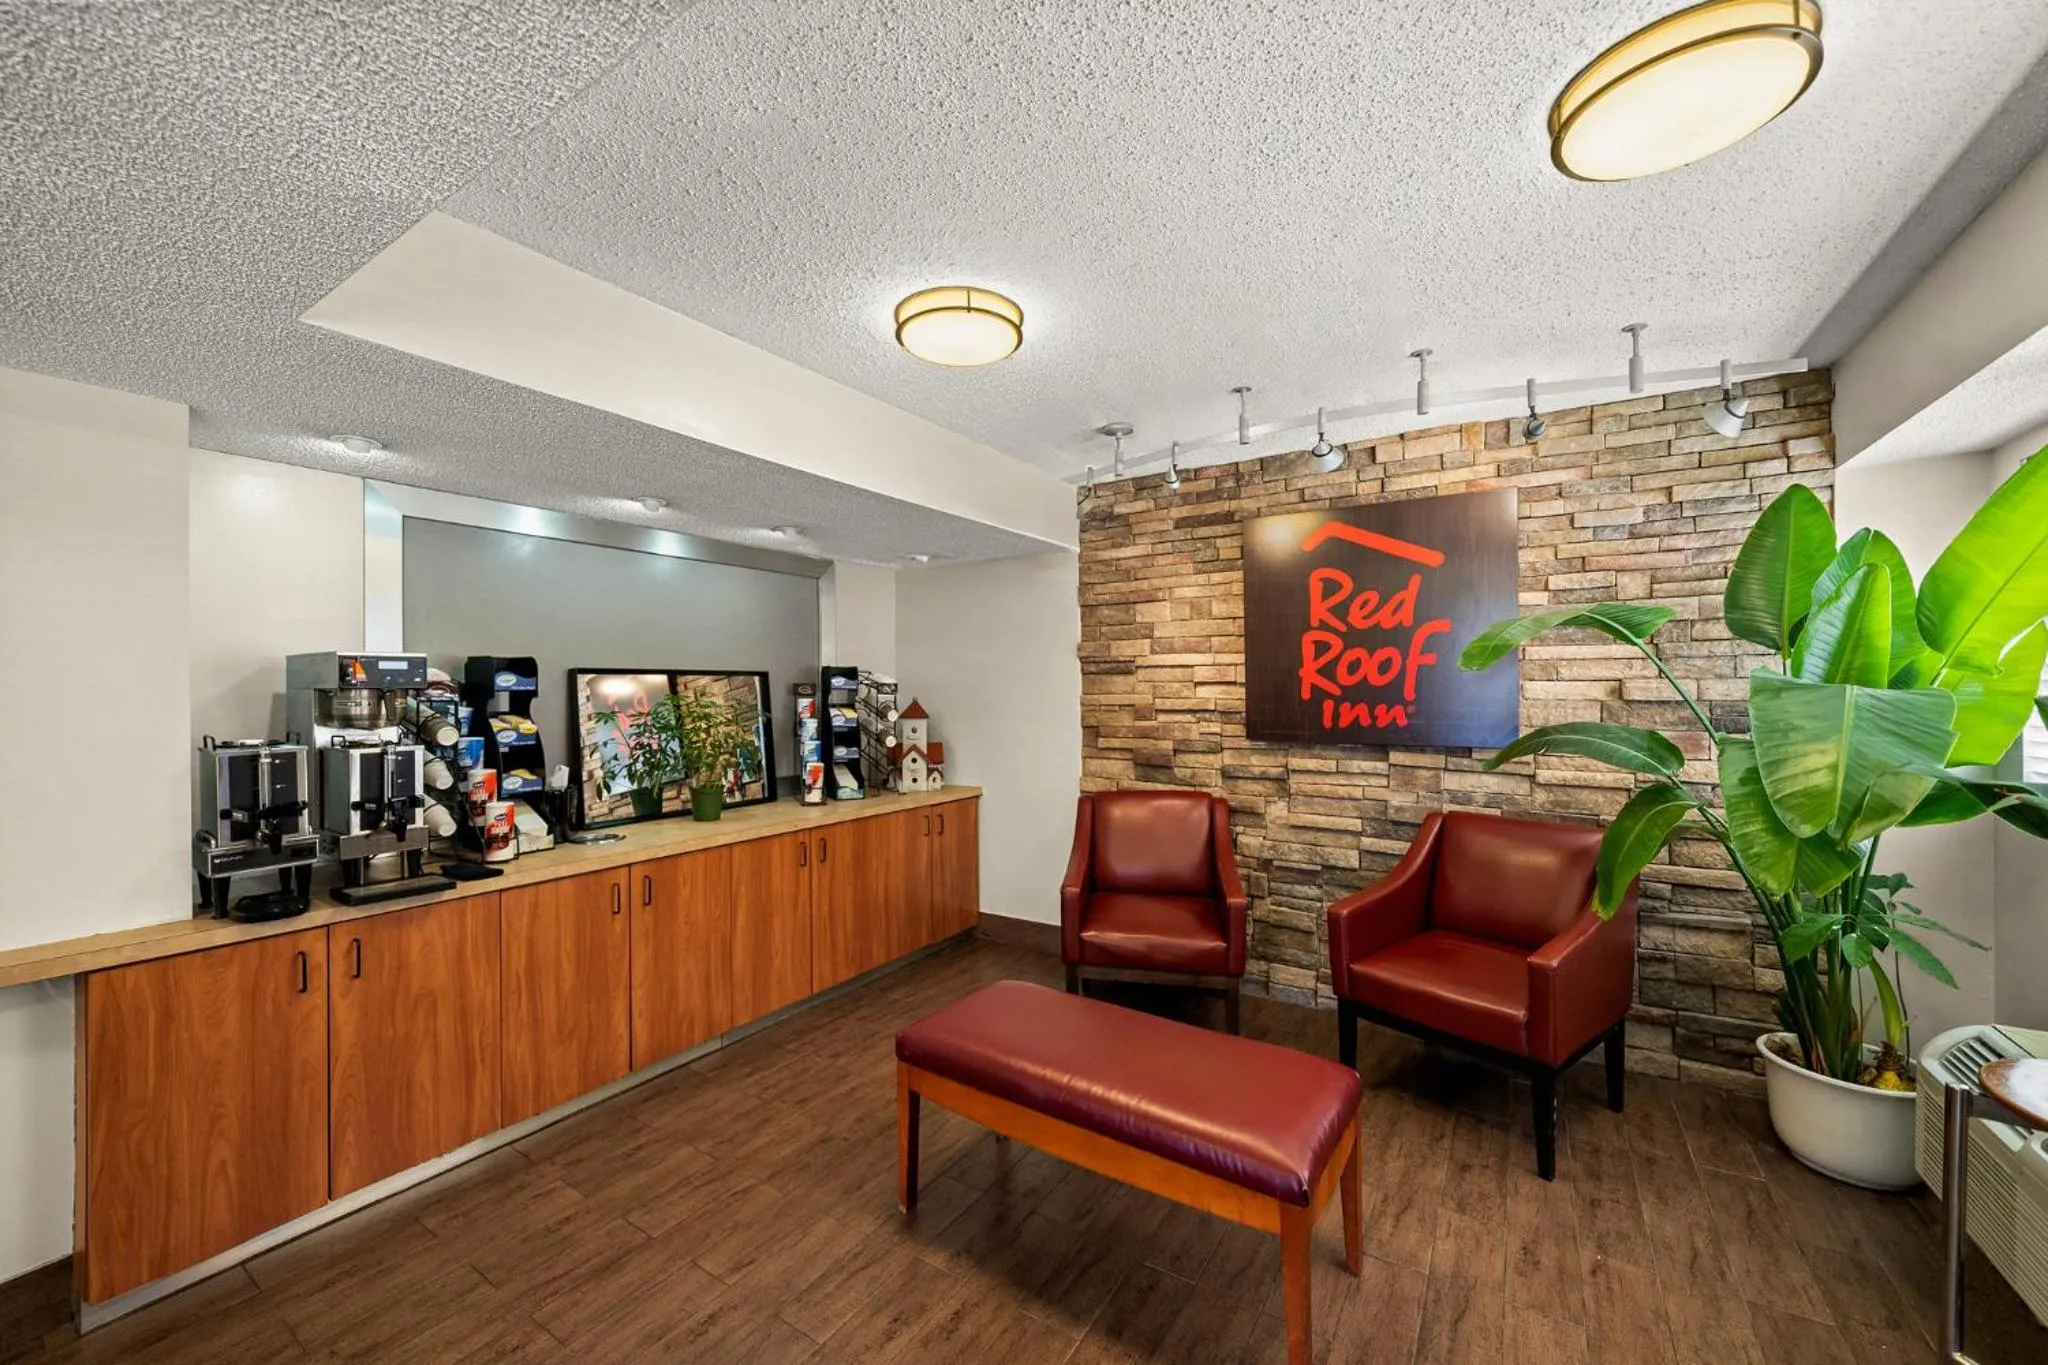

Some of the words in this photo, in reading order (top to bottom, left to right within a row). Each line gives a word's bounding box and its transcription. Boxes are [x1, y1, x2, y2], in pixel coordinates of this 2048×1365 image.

[1309, 567, 1421, 632] Red
[1299, 619, 1452, 700] Roof
[1322, 699, 1408, 729] Inn
